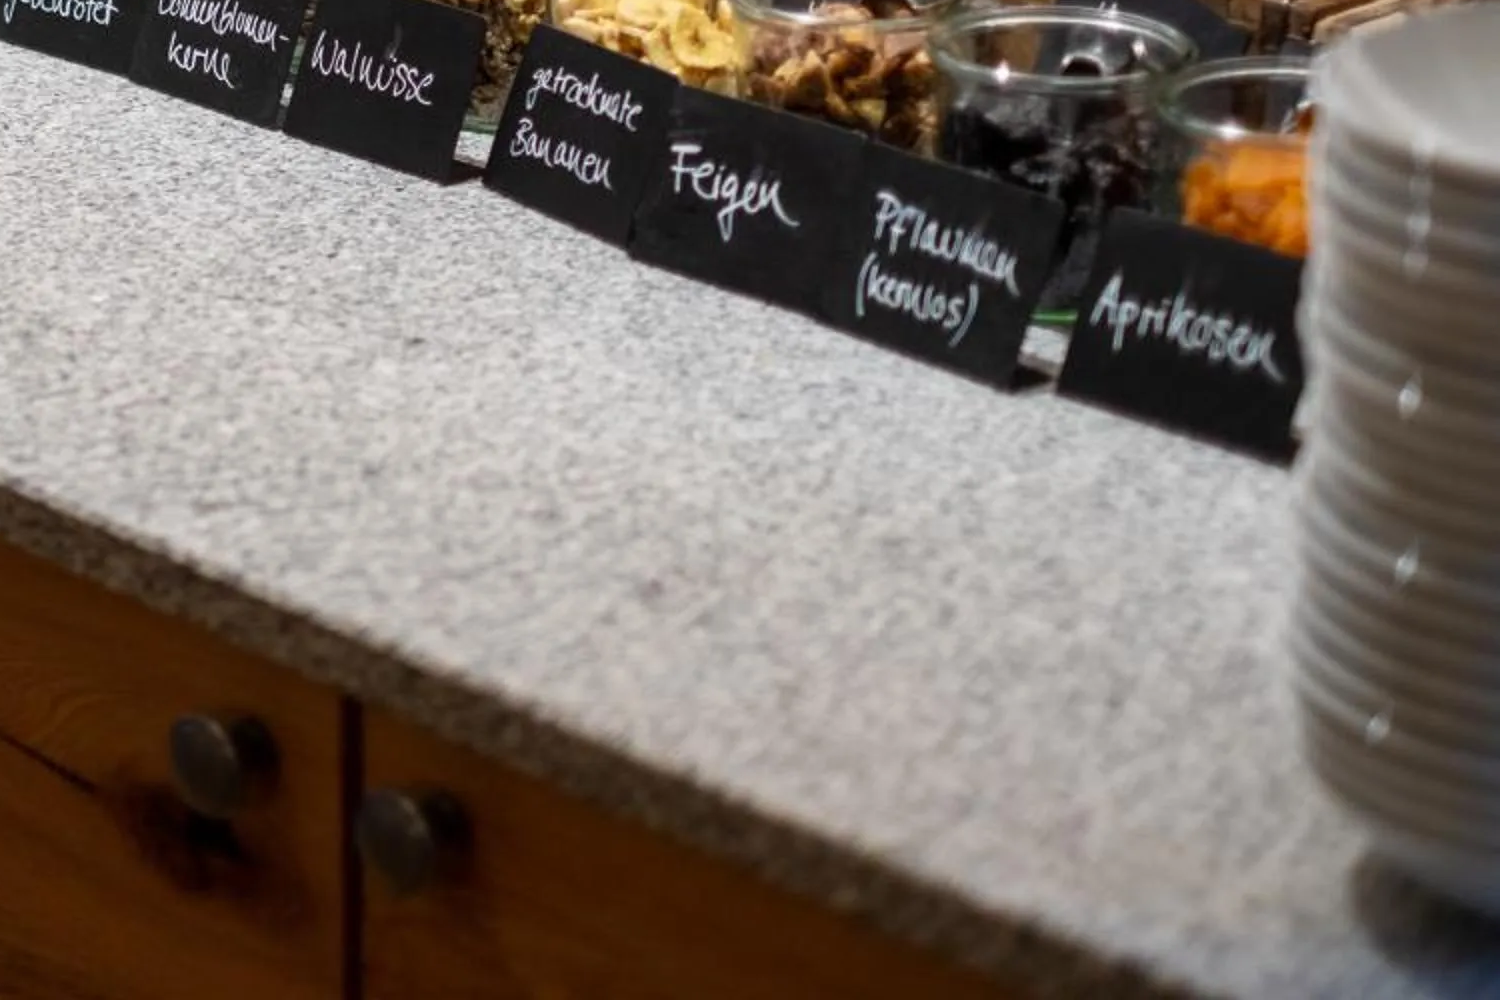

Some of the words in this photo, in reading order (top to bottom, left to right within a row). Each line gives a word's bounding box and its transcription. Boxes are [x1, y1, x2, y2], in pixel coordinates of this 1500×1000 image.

[311, 29, 435, 105] Walnüsse
[510, 118, 613, 190] Bananen
[669, 143, 800, 242] Feigen
[1089, 266, 1284, 383] Aprikosen
